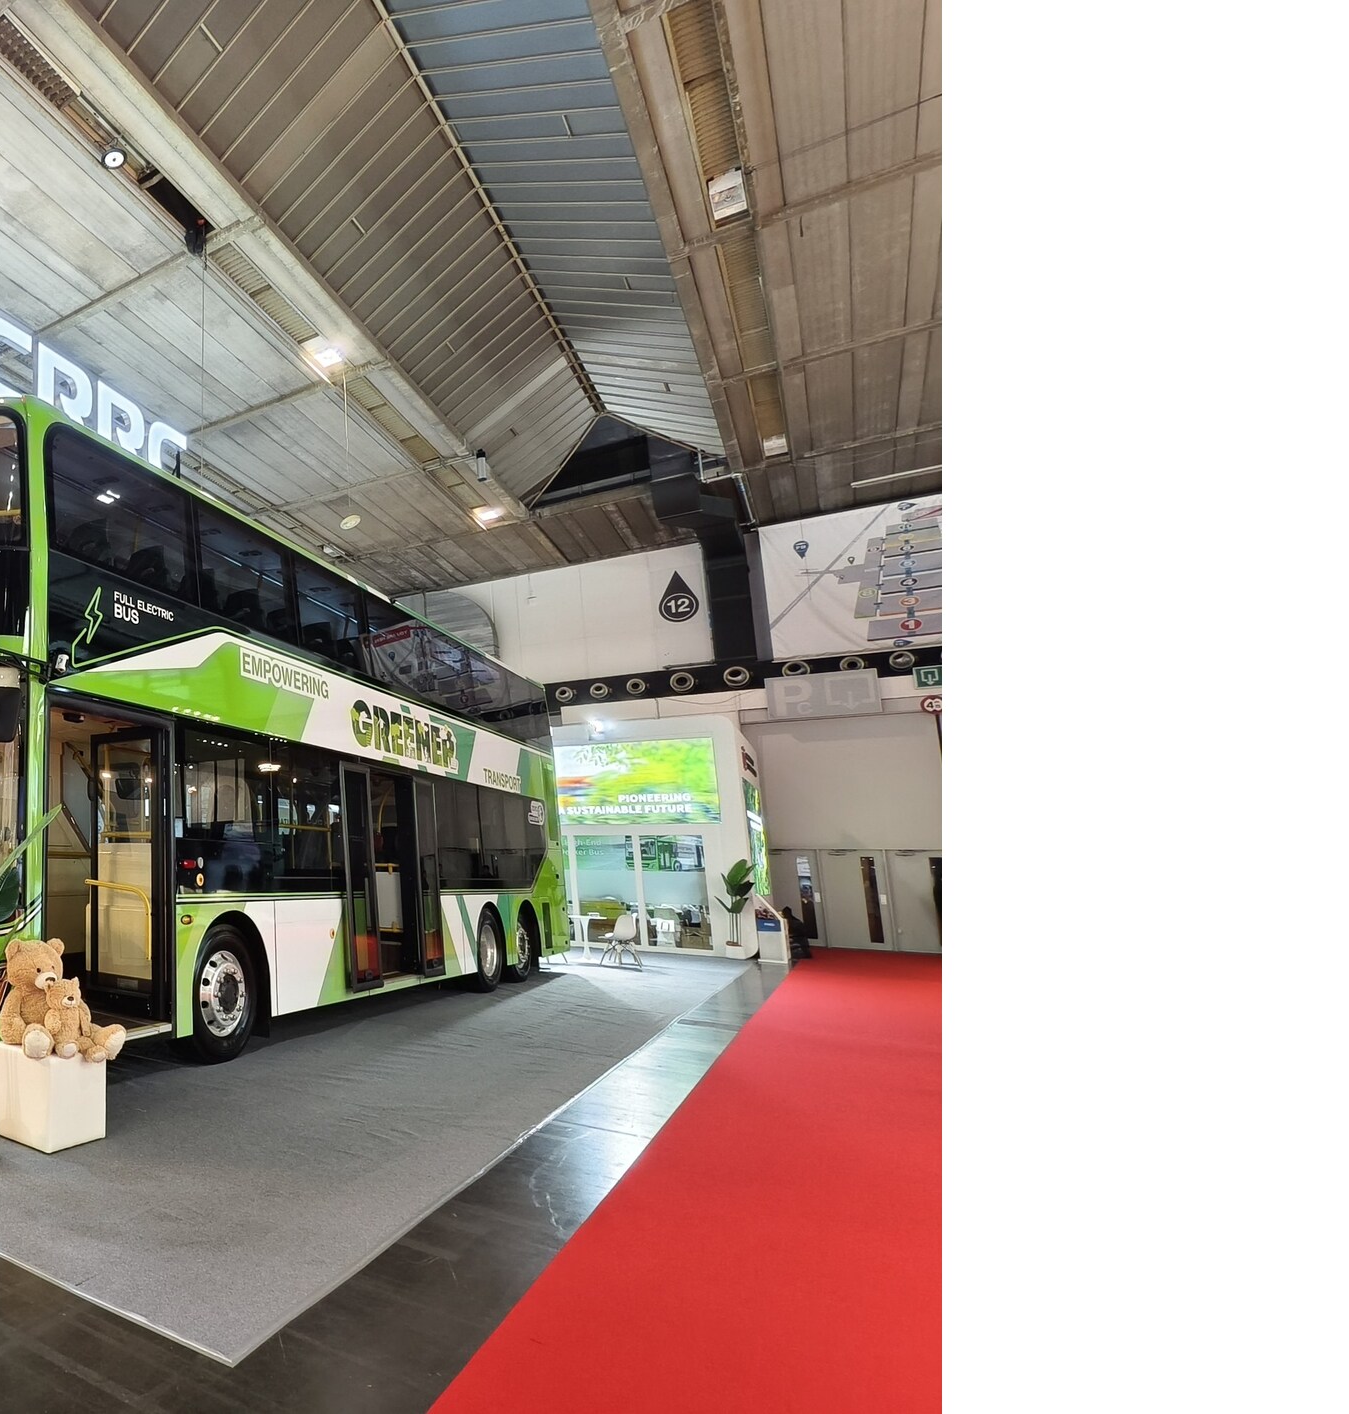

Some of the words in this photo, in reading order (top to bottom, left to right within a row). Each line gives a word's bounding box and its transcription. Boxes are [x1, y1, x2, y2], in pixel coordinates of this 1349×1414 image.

[113, 590, 136, 608] FULL
[137, 599, 174, 622] ELECTRIC
[113, 605, 140, 625] BUS
[666, 598, 691, 614] 12
[241, 652, 330, 700] EMPOWERING
[350, 699, 457, 770] GREENER
[482, 767, 522, 792] TRANSPORT
[567, 804, 643, 815] SUSTAINABLE
[644, 803, 693, 814] FUTURE
[617, 792, 692, 804] PIONEERING
